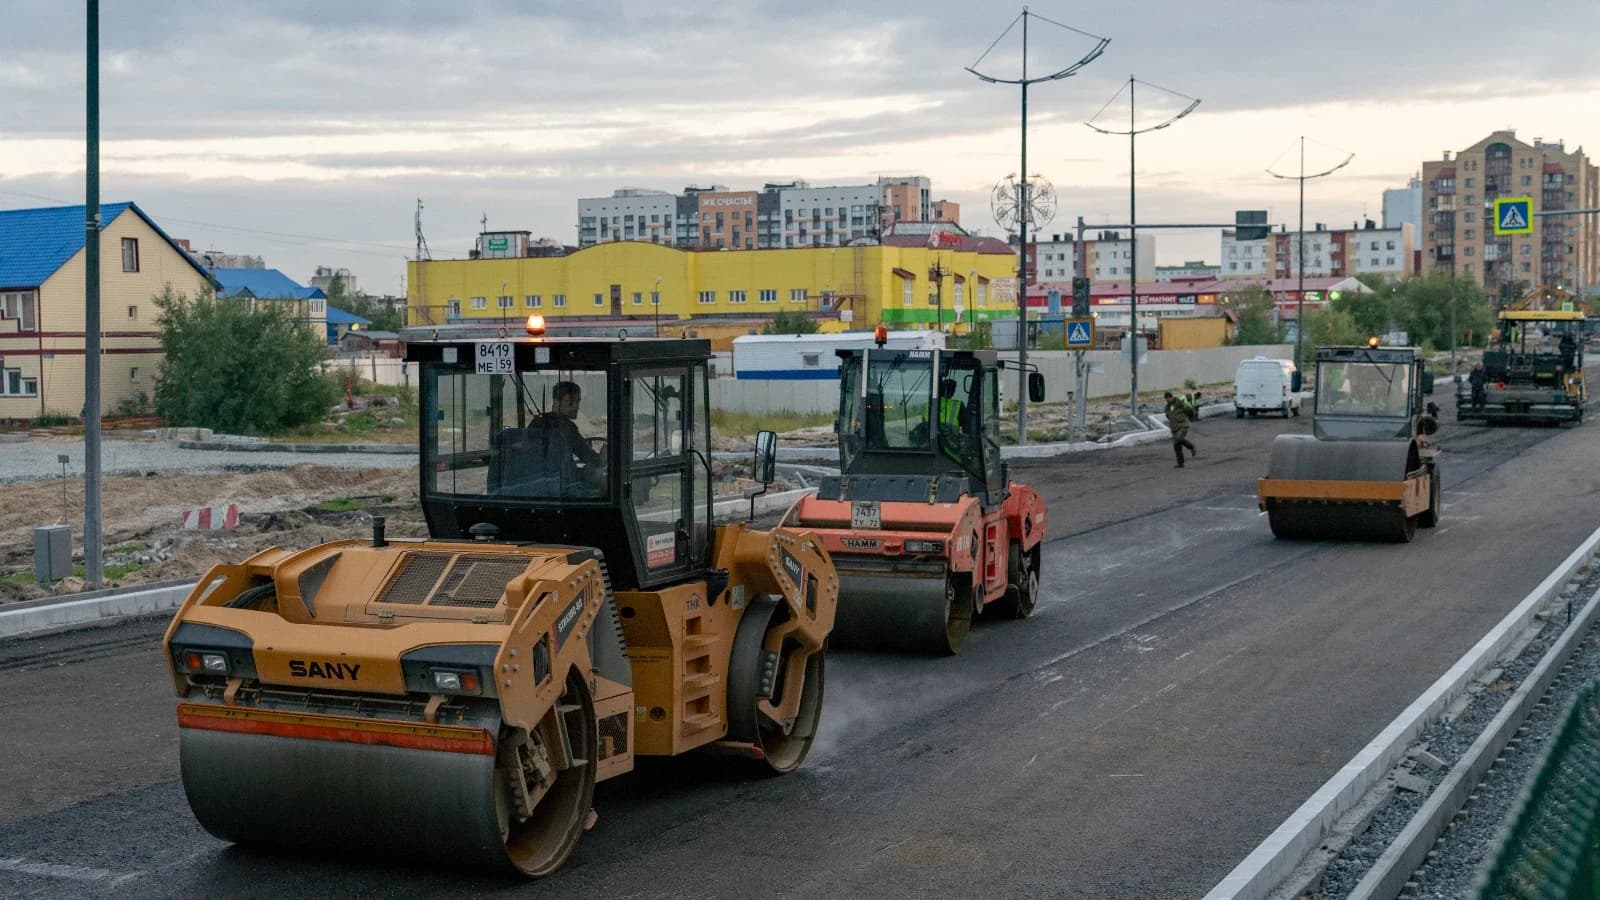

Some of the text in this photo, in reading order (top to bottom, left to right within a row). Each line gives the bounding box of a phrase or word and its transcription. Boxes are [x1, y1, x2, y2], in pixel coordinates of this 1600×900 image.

[480, 344, 509, 357] 8419
[500, 359, 512, 369] 59
[855, 507, 877, 517] 7437
[869, 519, 878, 527] 72
[847, 539, 878, 547] HAMM
[288, 660, 361, 681] SANY
